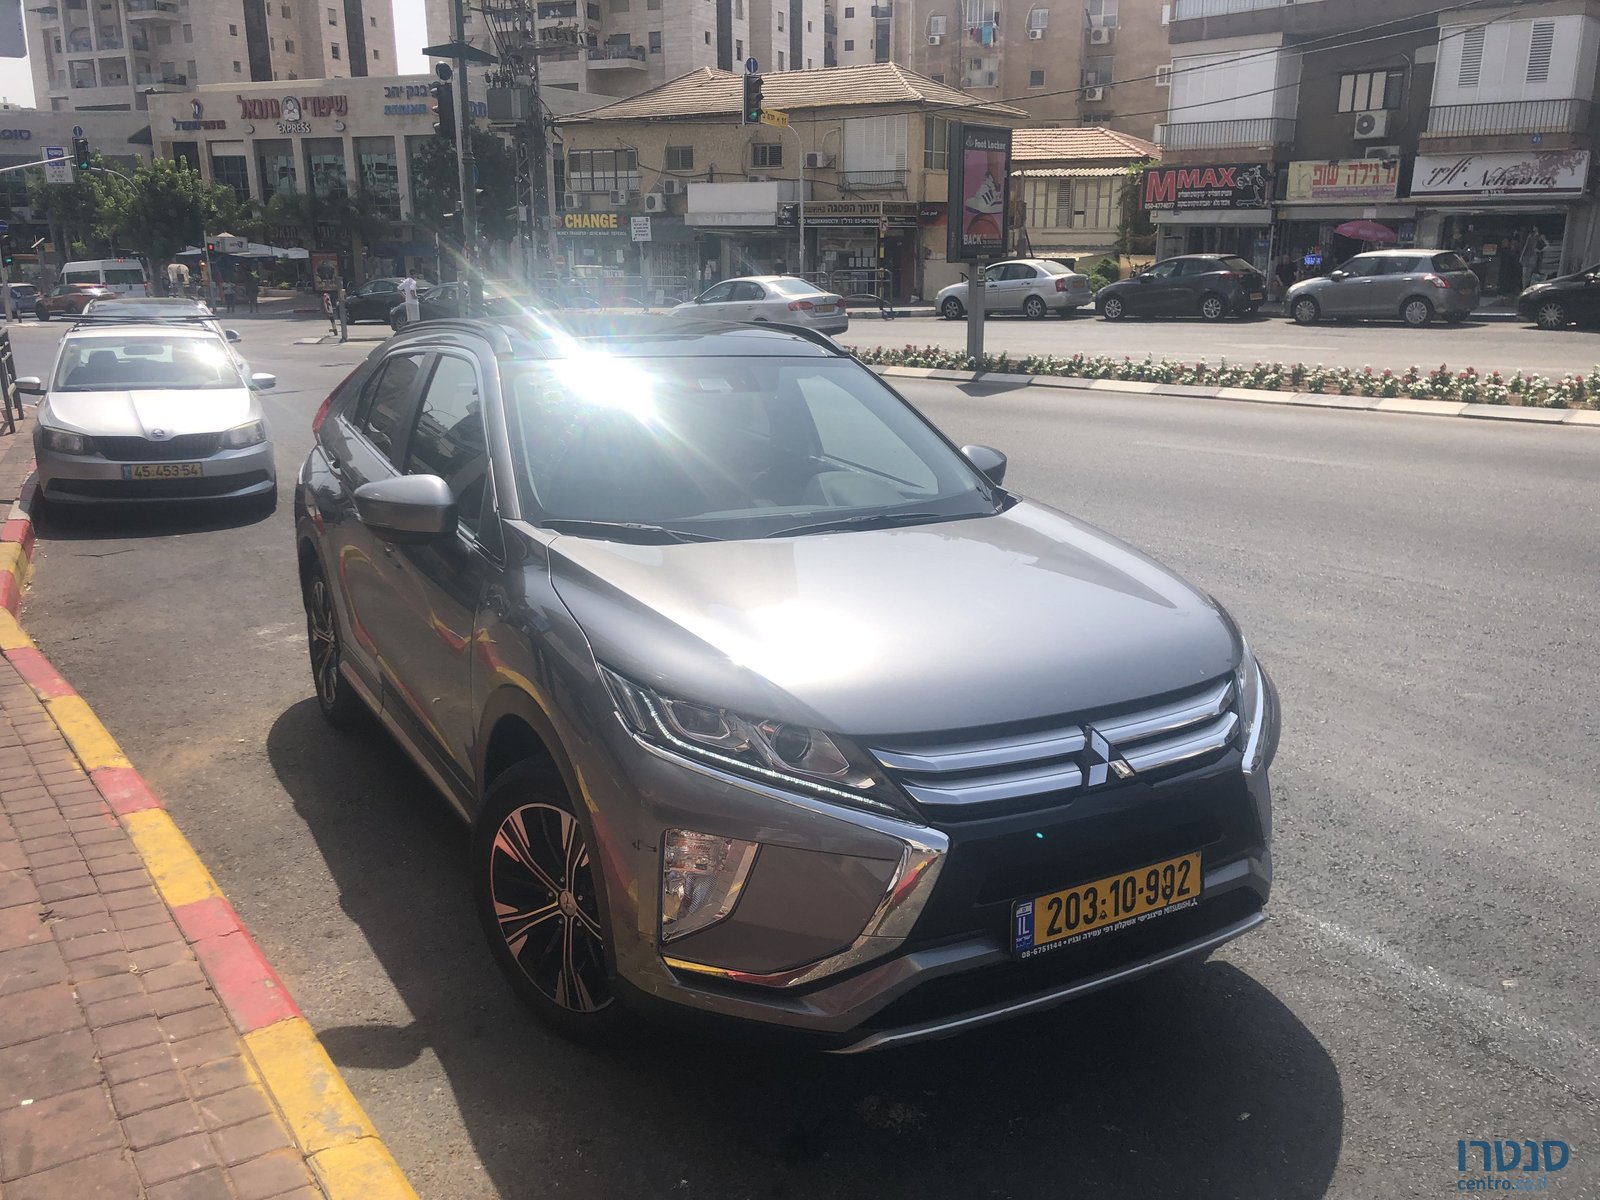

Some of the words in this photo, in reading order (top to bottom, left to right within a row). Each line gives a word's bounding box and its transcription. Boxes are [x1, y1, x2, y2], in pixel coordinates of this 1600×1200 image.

[277, 122, 311, 134] EXPRESS
[1145, 167, 1237, 203] MMAX
[827, 203, 856, 213] הפסגה
[858, 203, 880, 215] תיווך
[565, 214, 618, 228] CHANGE
[963, 233, 982, 246] BACK
[1018, 916, 1030, 936] IL
